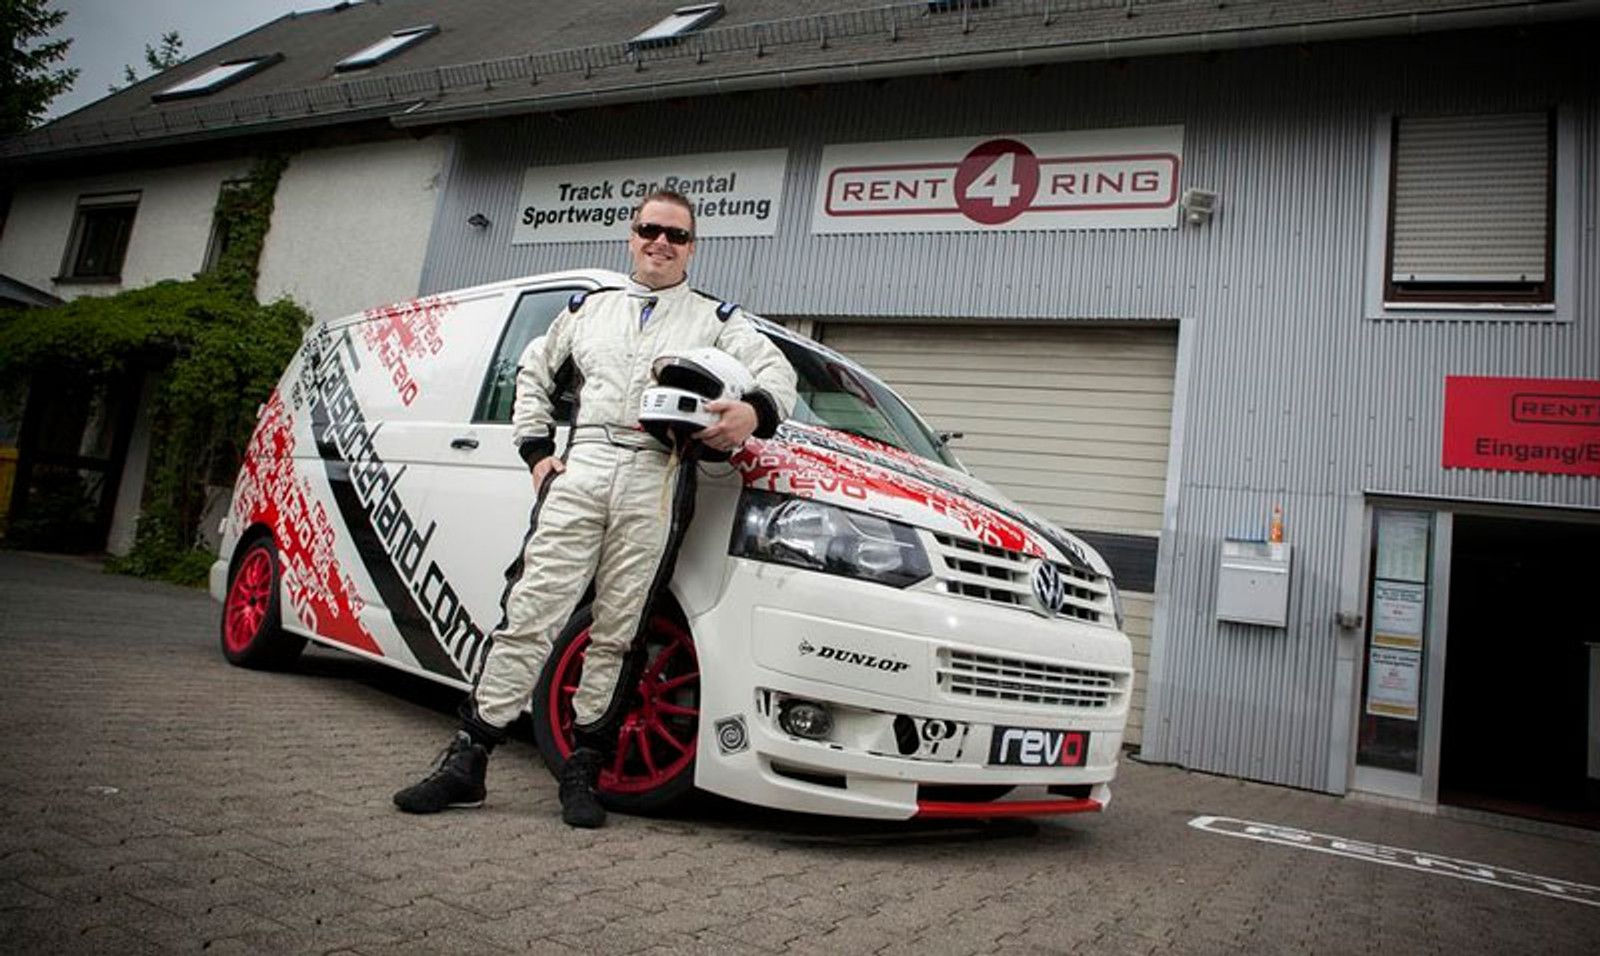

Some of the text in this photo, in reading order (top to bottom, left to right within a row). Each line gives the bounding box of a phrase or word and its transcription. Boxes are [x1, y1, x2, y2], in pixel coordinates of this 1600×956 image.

[558, 172, 737, 202] Track Car Rental
[842, 151, 1160, 208] RENT 4 RING
[816, 645, 911, 673] DUNLOP
[999, 728, 1083, 765] revo
